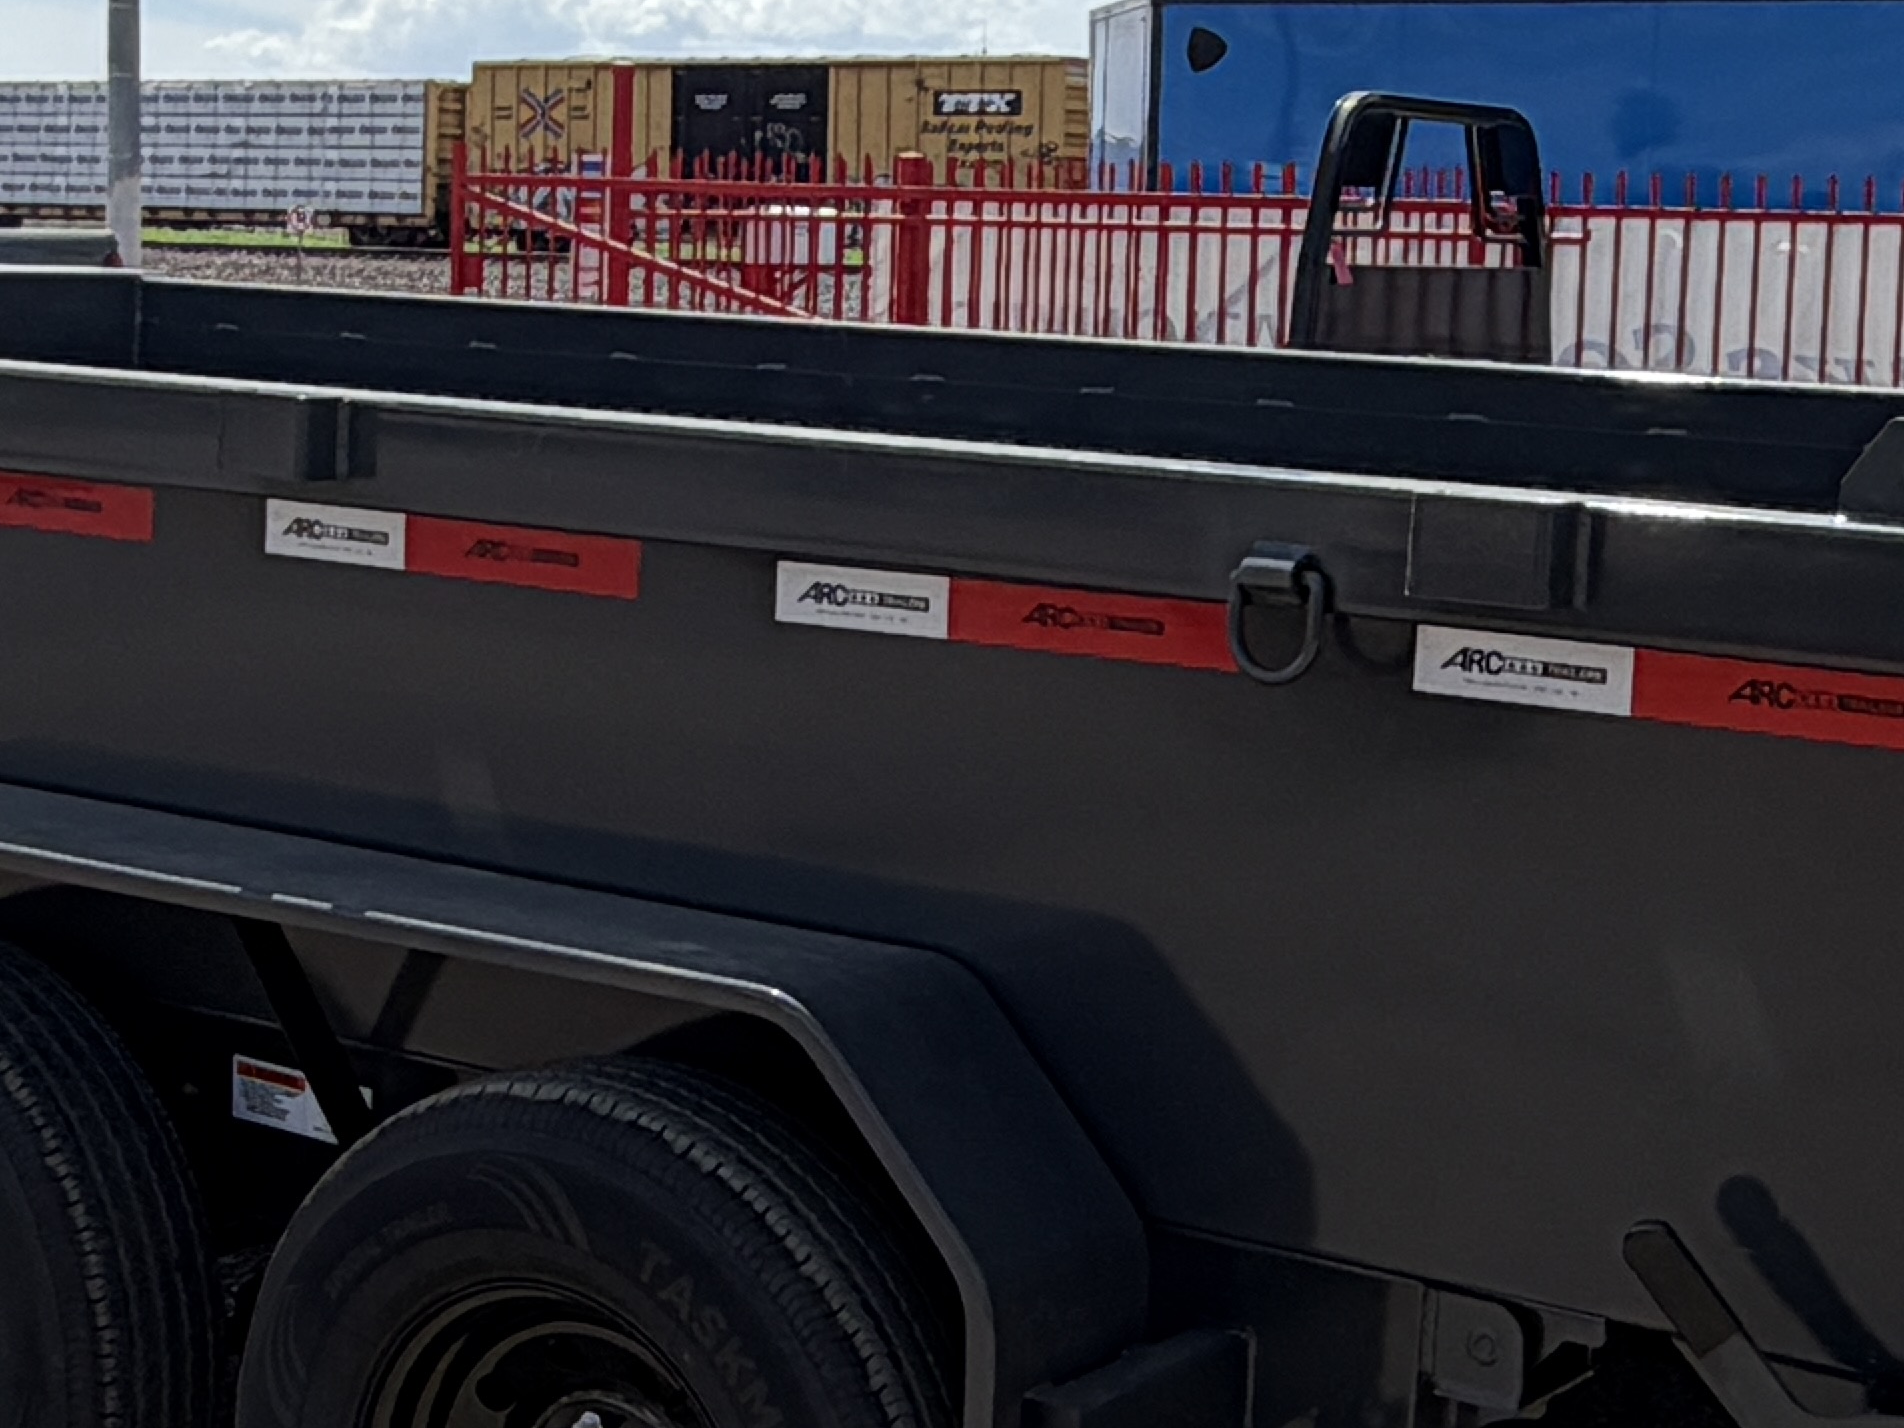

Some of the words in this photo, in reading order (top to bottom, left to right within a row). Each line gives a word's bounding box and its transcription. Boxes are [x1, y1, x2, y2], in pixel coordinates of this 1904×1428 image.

[281, 516, 323, 541] ARC
[797, 580, 848, 608] ARC
[1440, 646, 1504, 676] ARC
[1728, 678, 1795, 710] ARC
